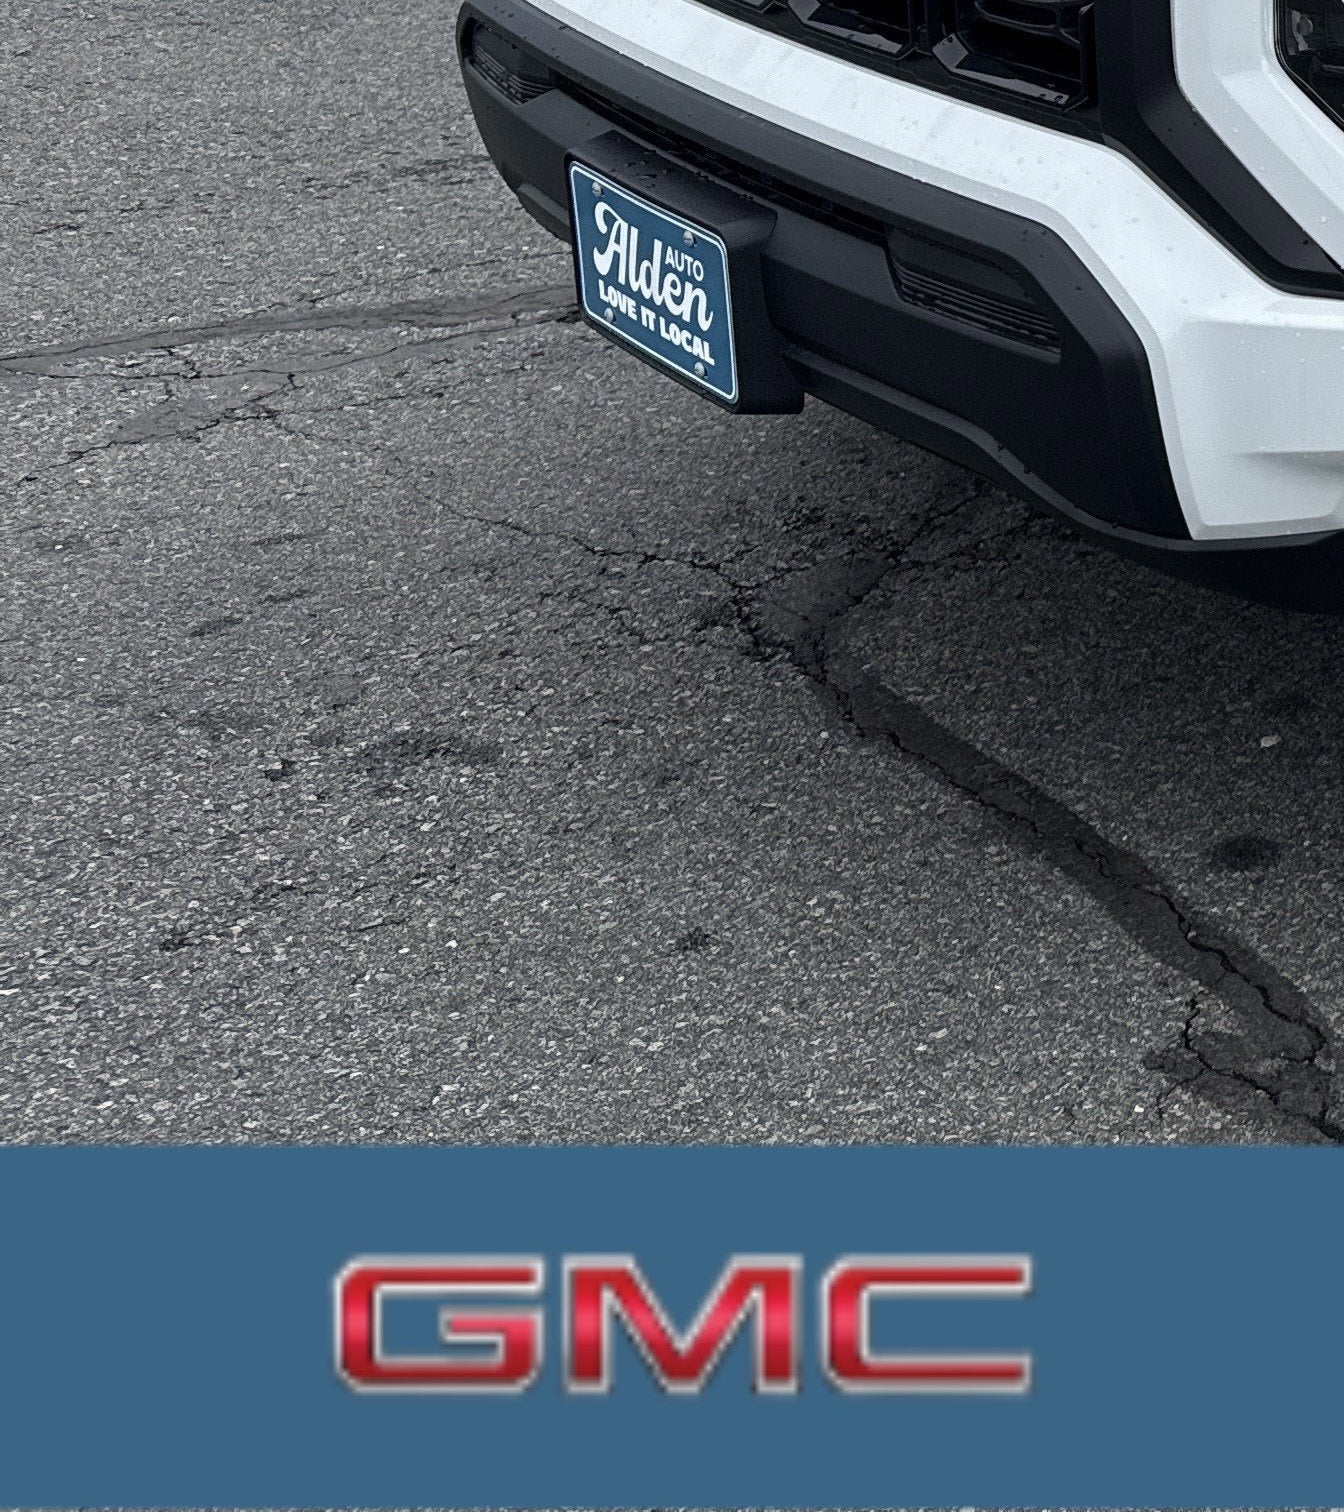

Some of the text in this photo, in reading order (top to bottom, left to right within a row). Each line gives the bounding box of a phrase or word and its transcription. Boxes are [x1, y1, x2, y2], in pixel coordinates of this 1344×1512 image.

[594, 201, 714, 332] Alden
[665, 245, 704, 282] AUTO
[598, 279, 716, 366] LOVE IT LOCAL
